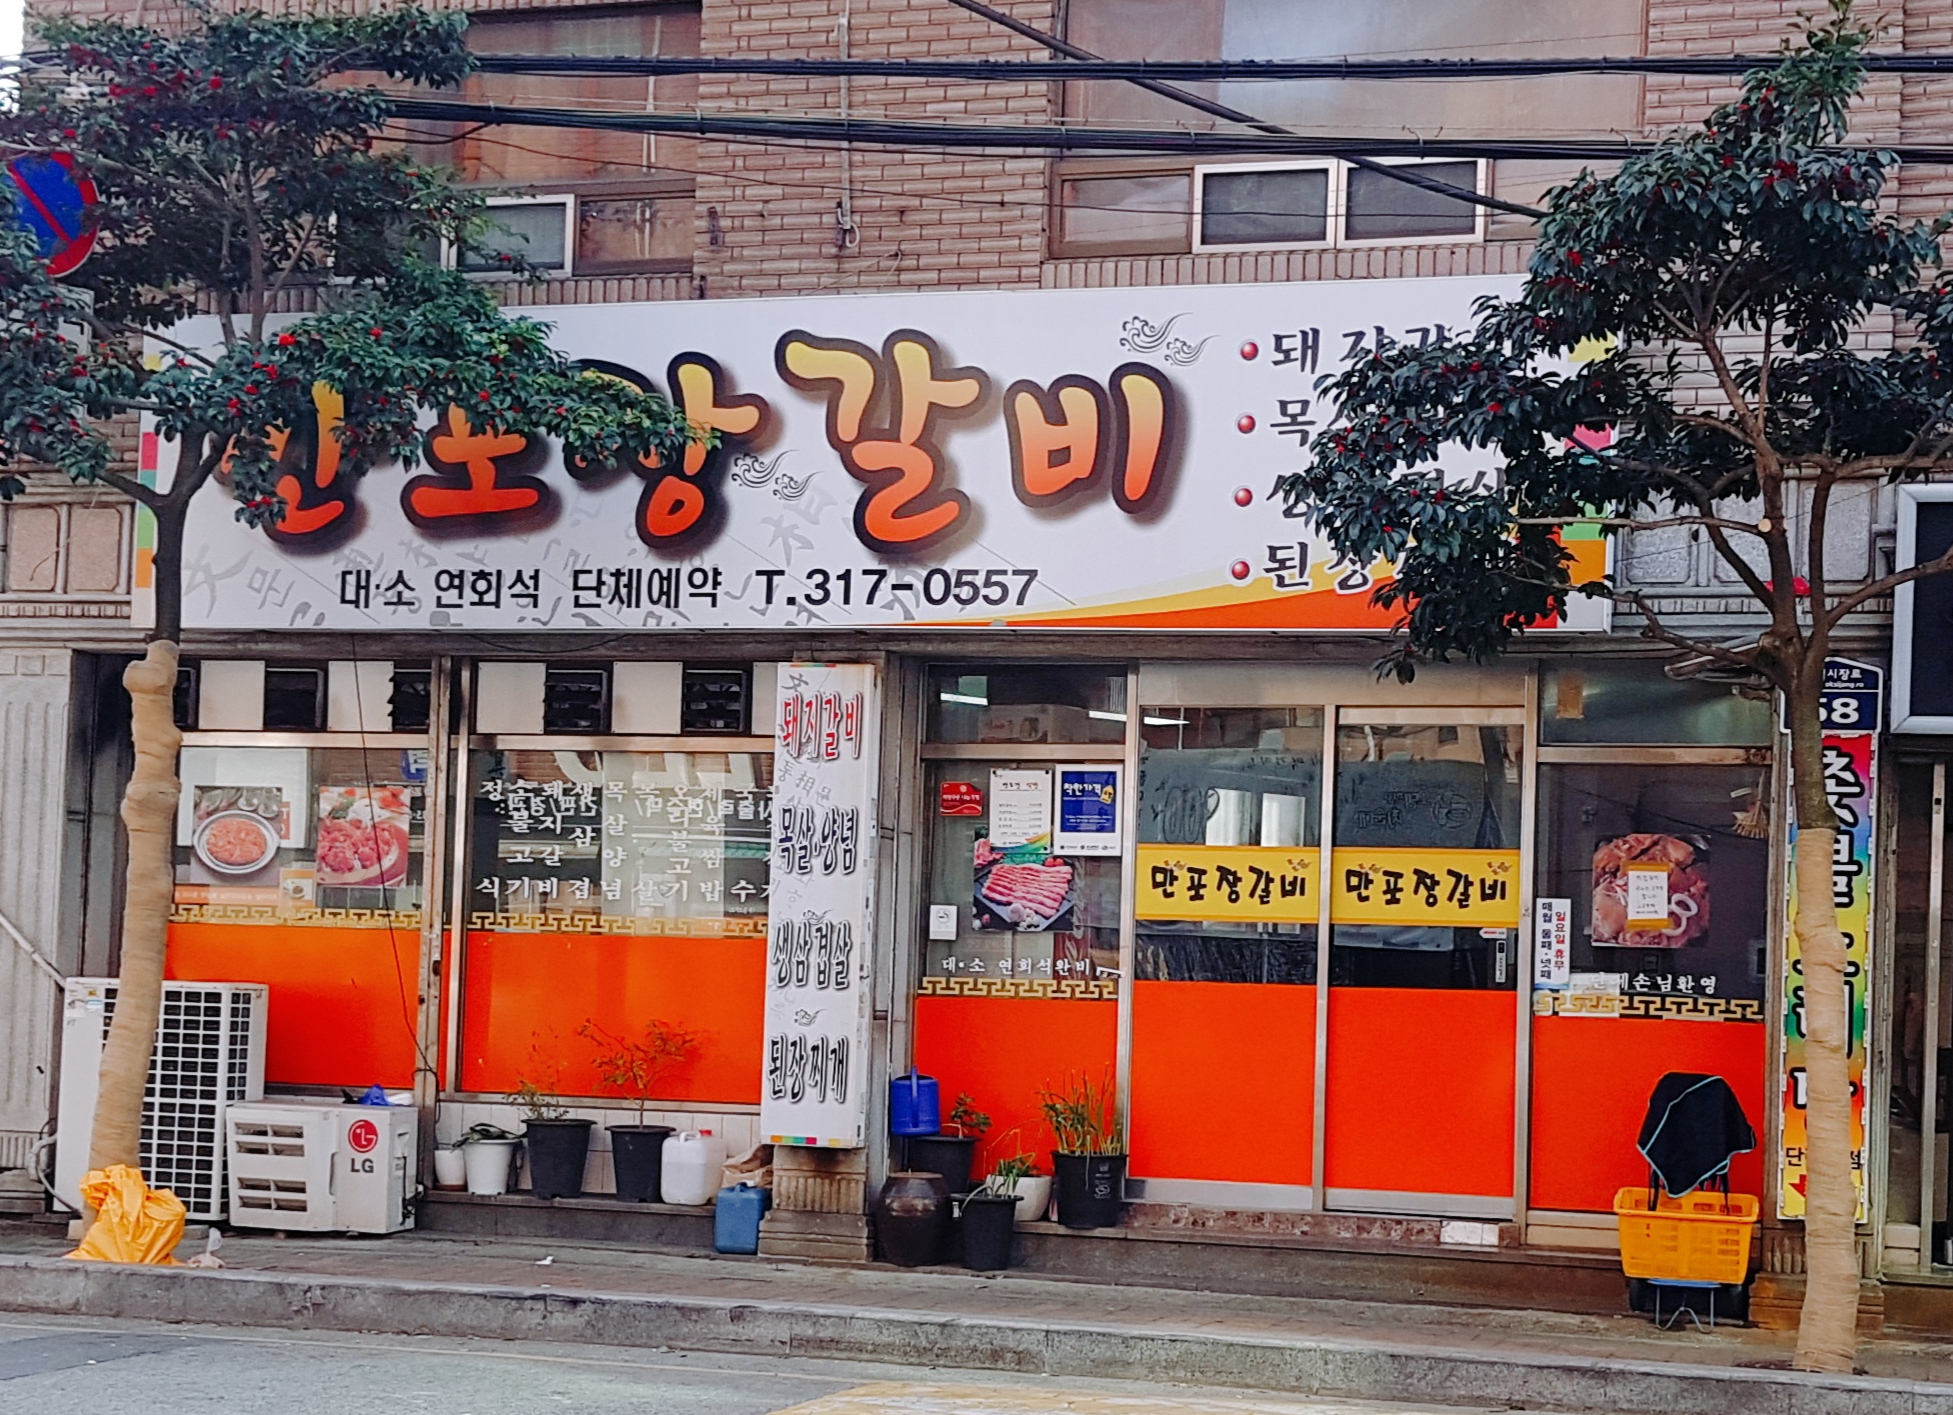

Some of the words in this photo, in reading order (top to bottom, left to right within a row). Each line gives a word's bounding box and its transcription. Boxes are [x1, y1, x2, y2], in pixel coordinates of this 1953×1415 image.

[435, 569, 541, 610] 연회석
[572, 567, 723, 609] 단체예약
[756, 567, 1039, 608] T.317-0557
[1823, 668, 1862, 681] 시장로
[782, 691, 862, 759] 돼지갈비
[536, 779, 565, 899] 돼지갈비
[1151, 864, 1306, 904] 만포장갈비
[1345, 868, 1507, 909] 만포장갈비
[1554, 911, 1566, 944] 일요일
[773, 918, 852, 989] 생삼겹살
[1554, 949, 1565, 971] 휴무
[768, 1033, 849, 1103] 된장찌개
[350, 1158, 374, 1174] LG
